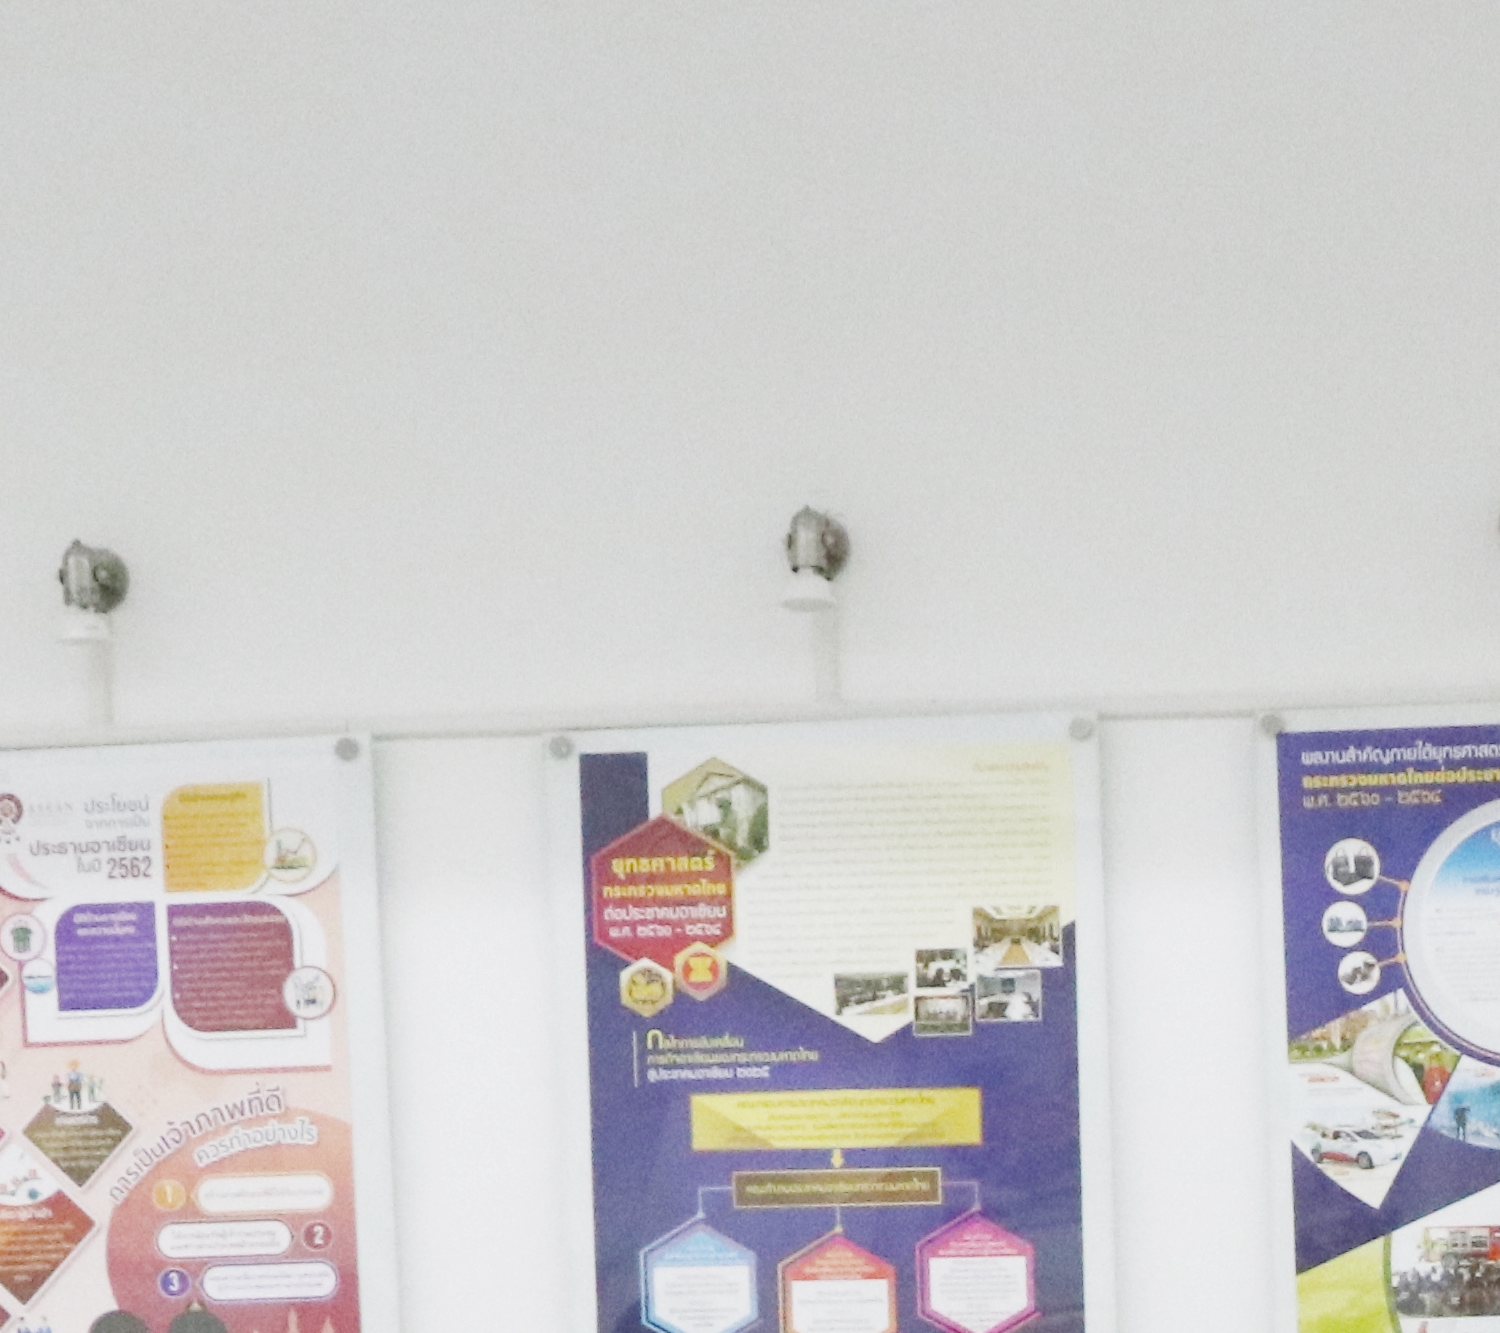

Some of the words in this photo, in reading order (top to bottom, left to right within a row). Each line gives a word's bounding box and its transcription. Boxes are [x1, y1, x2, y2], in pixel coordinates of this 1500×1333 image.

[108, 856, 151, 878] 2562
[109, 1081, 283, 1203] การเป็นเจ้าภาพที่ดี
[197, 1118, 318, 1164] ควรทำอย่างไร
[163, 1184, 173, 1204] 1
[313, 1225, 325, 1245] 2
[168, 1272, 180, 1293] 3
